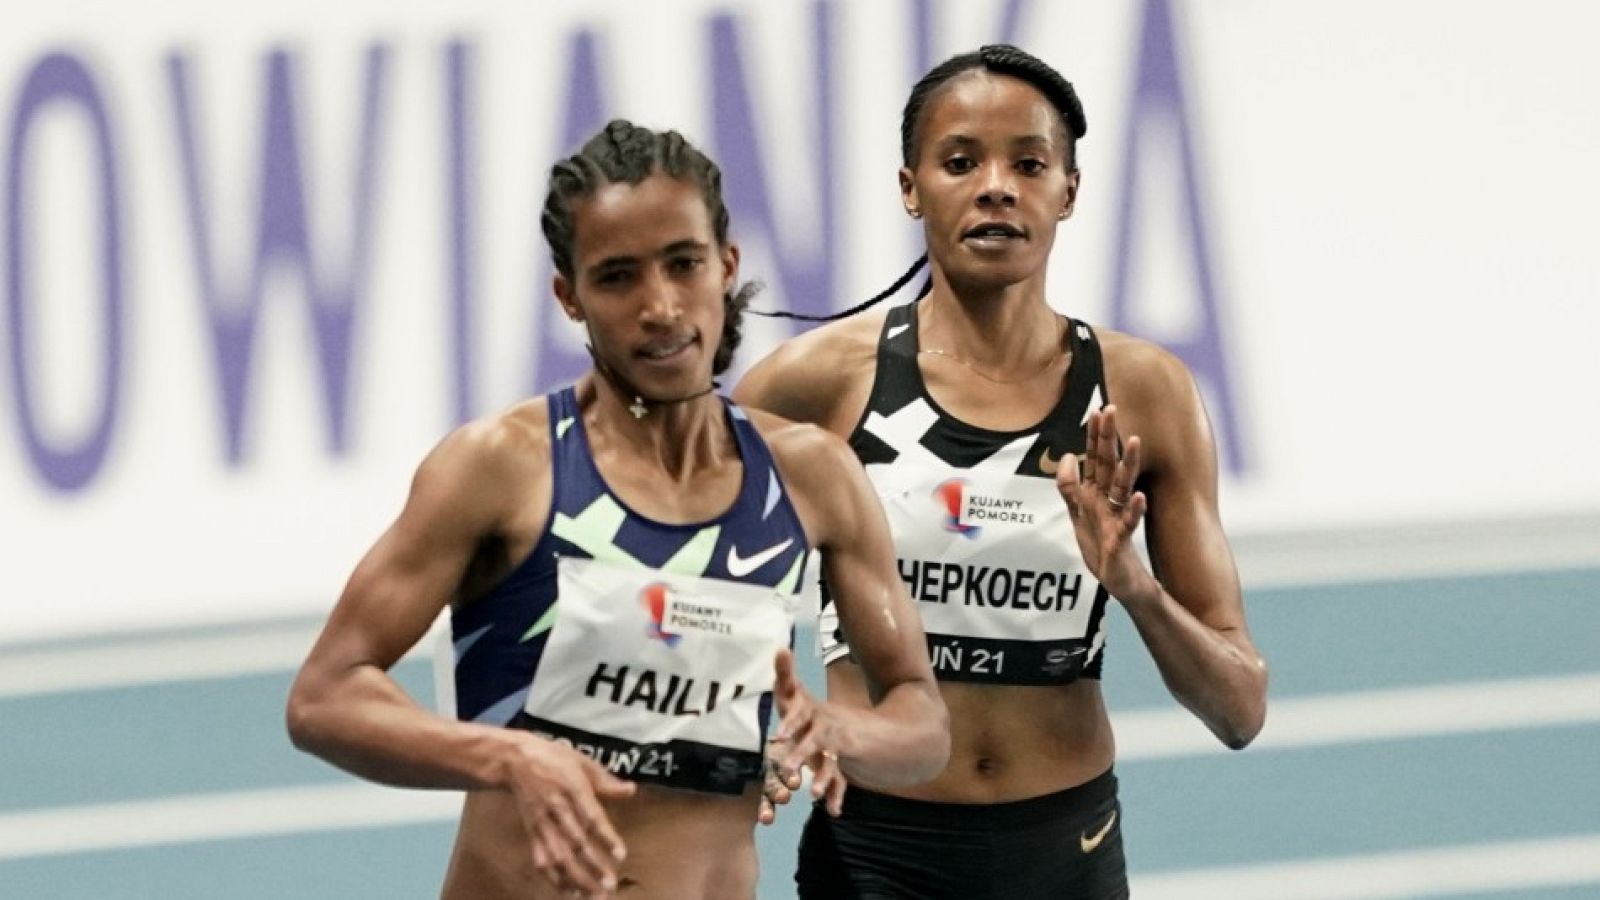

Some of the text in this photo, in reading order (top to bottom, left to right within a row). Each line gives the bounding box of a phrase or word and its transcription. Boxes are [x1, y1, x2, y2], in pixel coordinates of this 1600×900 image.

[5, 0, 1247, 492] OWIANA
[967, 508, 1035, 524] POMORZE
[969, 495, 1023, 510] KUJAWY
[897, 558, 1082, 611] HEPKOECH
[969, 648, 1005, 675] 21
